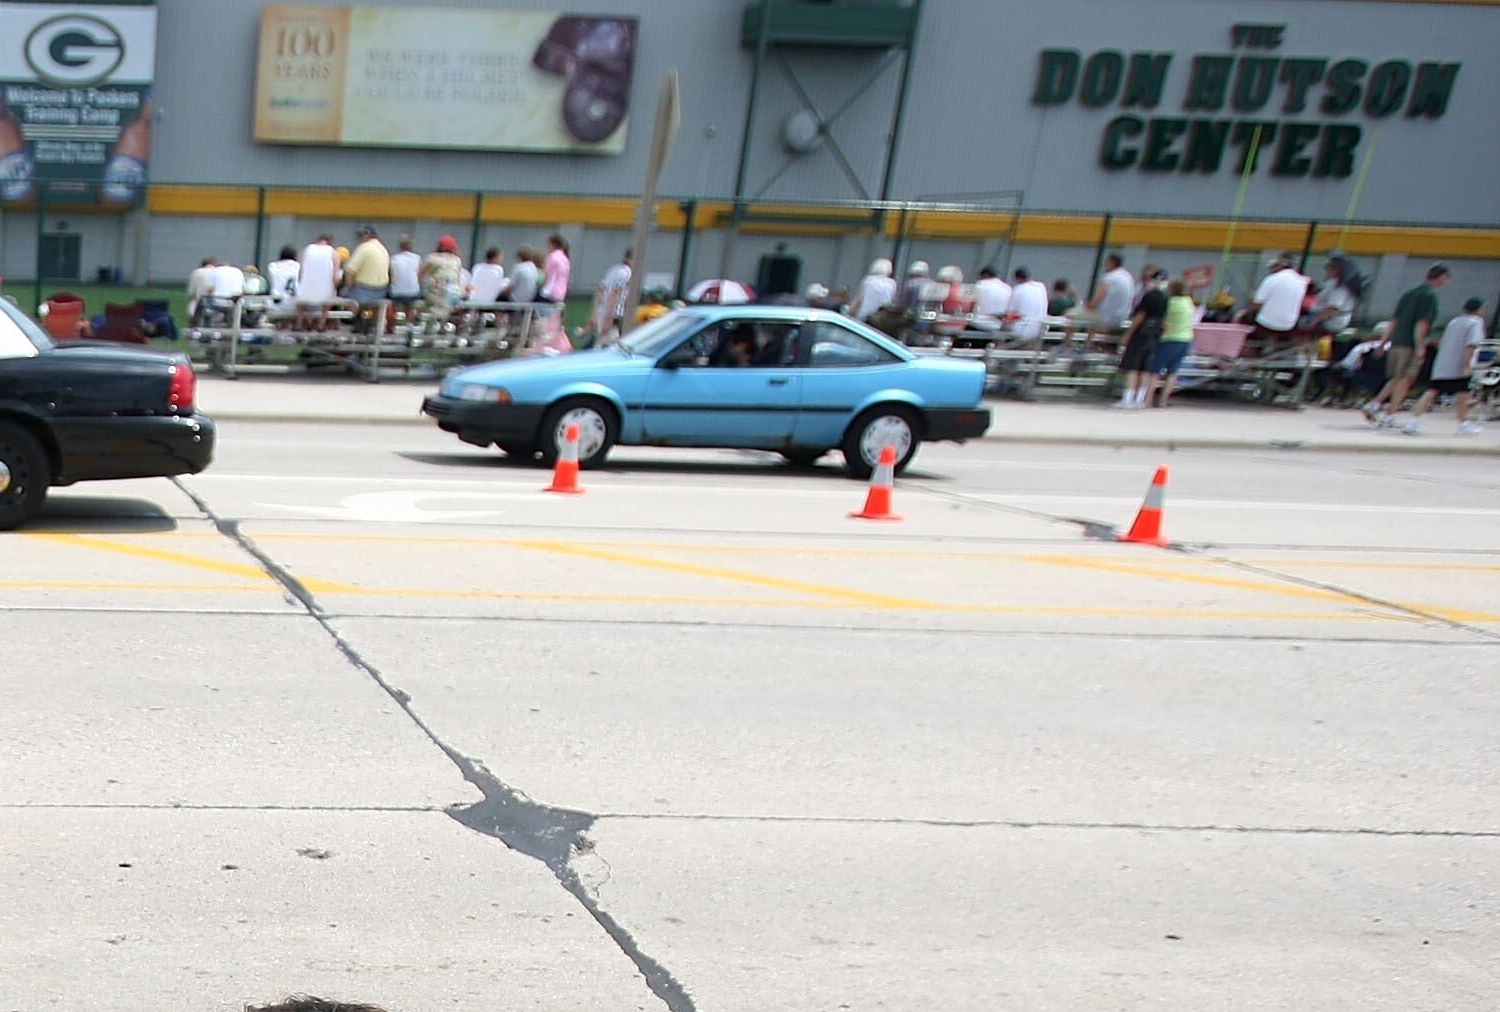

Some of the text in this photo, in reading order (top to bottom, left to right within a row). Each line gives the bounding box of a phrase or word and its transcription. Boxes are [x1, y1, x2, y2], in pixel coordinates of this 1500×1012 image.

[276, 24, 336, 56] 100
[1229, 24, 1287, 50] THE
[6, 86, 69, 105] Welcome
[1031, 48, 1462, 119] DON HUTSON
[25, 104, 121, 125] Training Camp
[1100, 115, 1361, 177] CENTER
